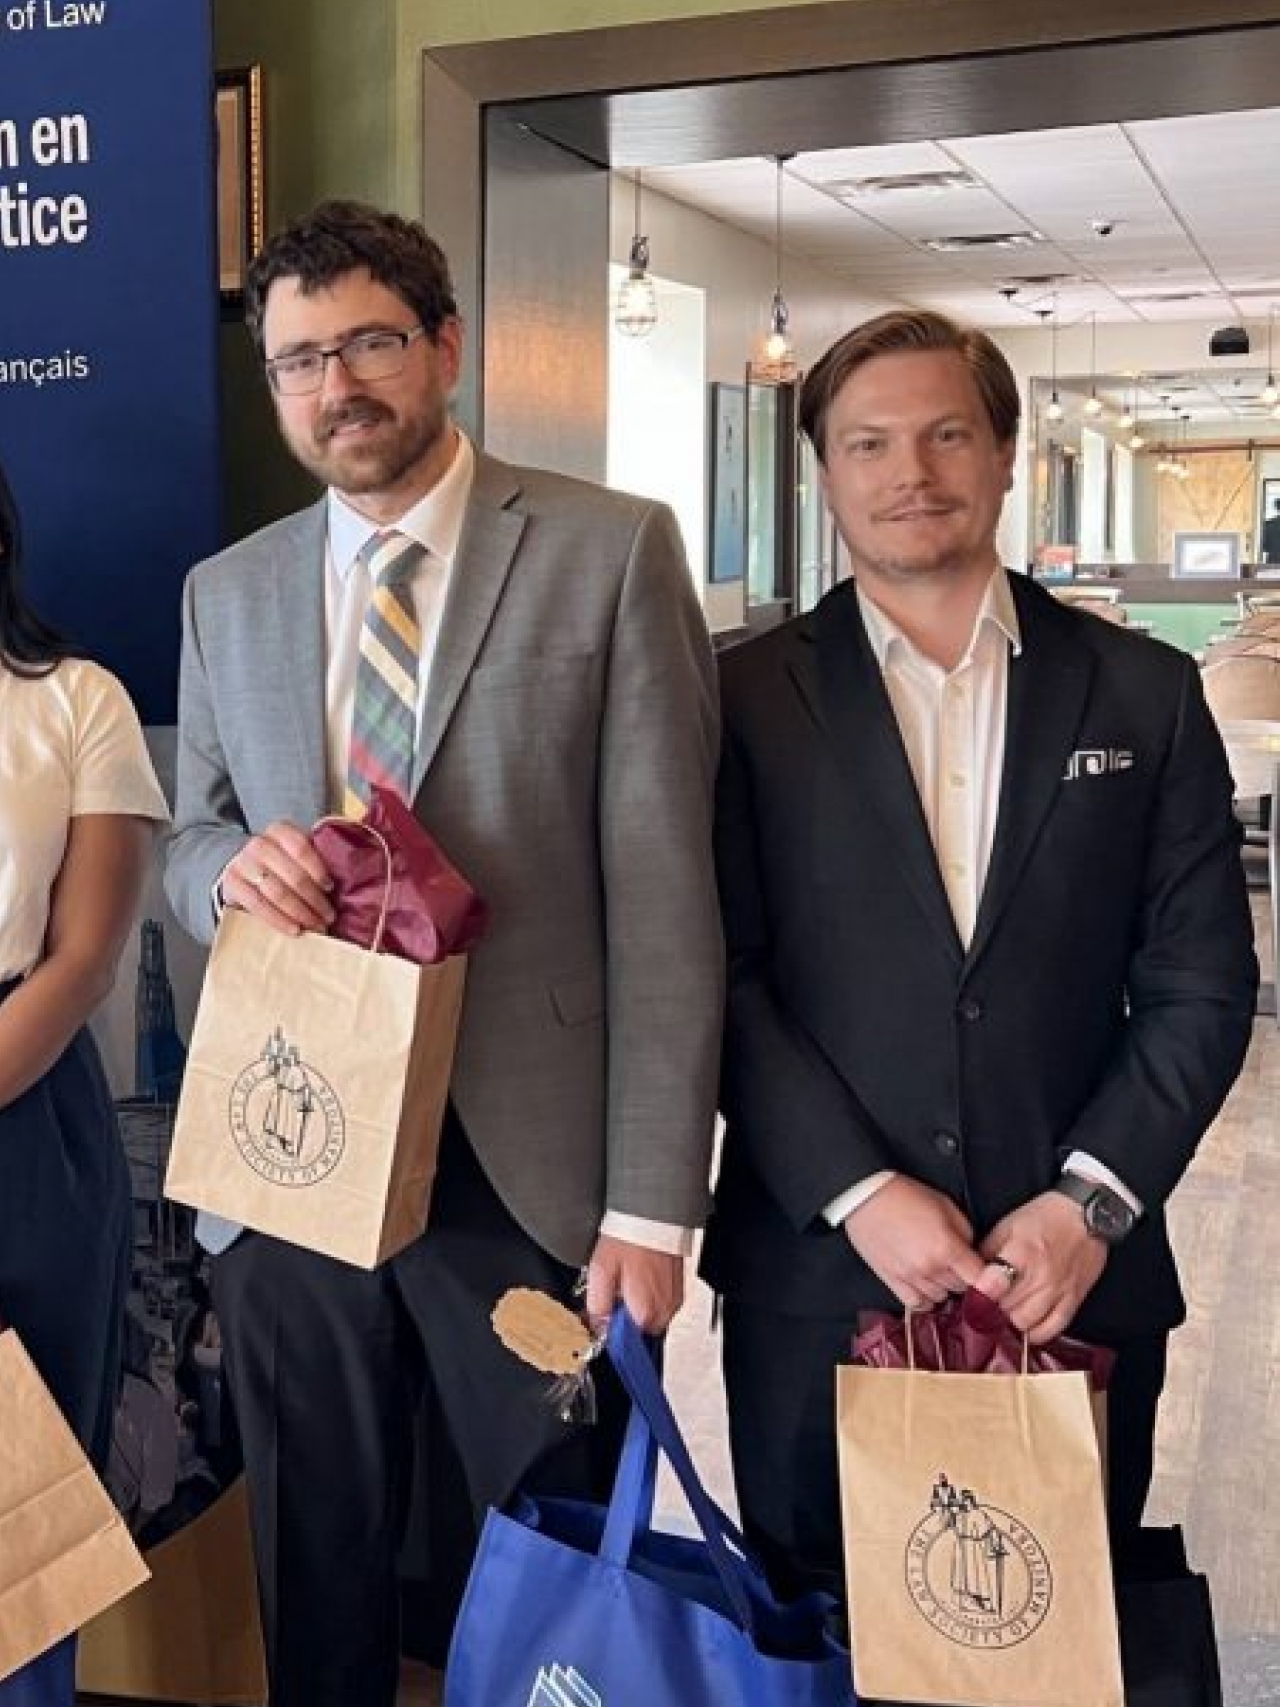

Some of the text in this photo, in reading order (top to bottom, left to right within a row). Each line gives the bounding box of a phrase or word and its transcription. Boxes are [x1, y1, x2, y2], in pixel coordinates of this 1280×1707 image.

[7, 3, 36, 30] of
[46, 0, 107, 27] Law
[31, 112, 90, 165] en
